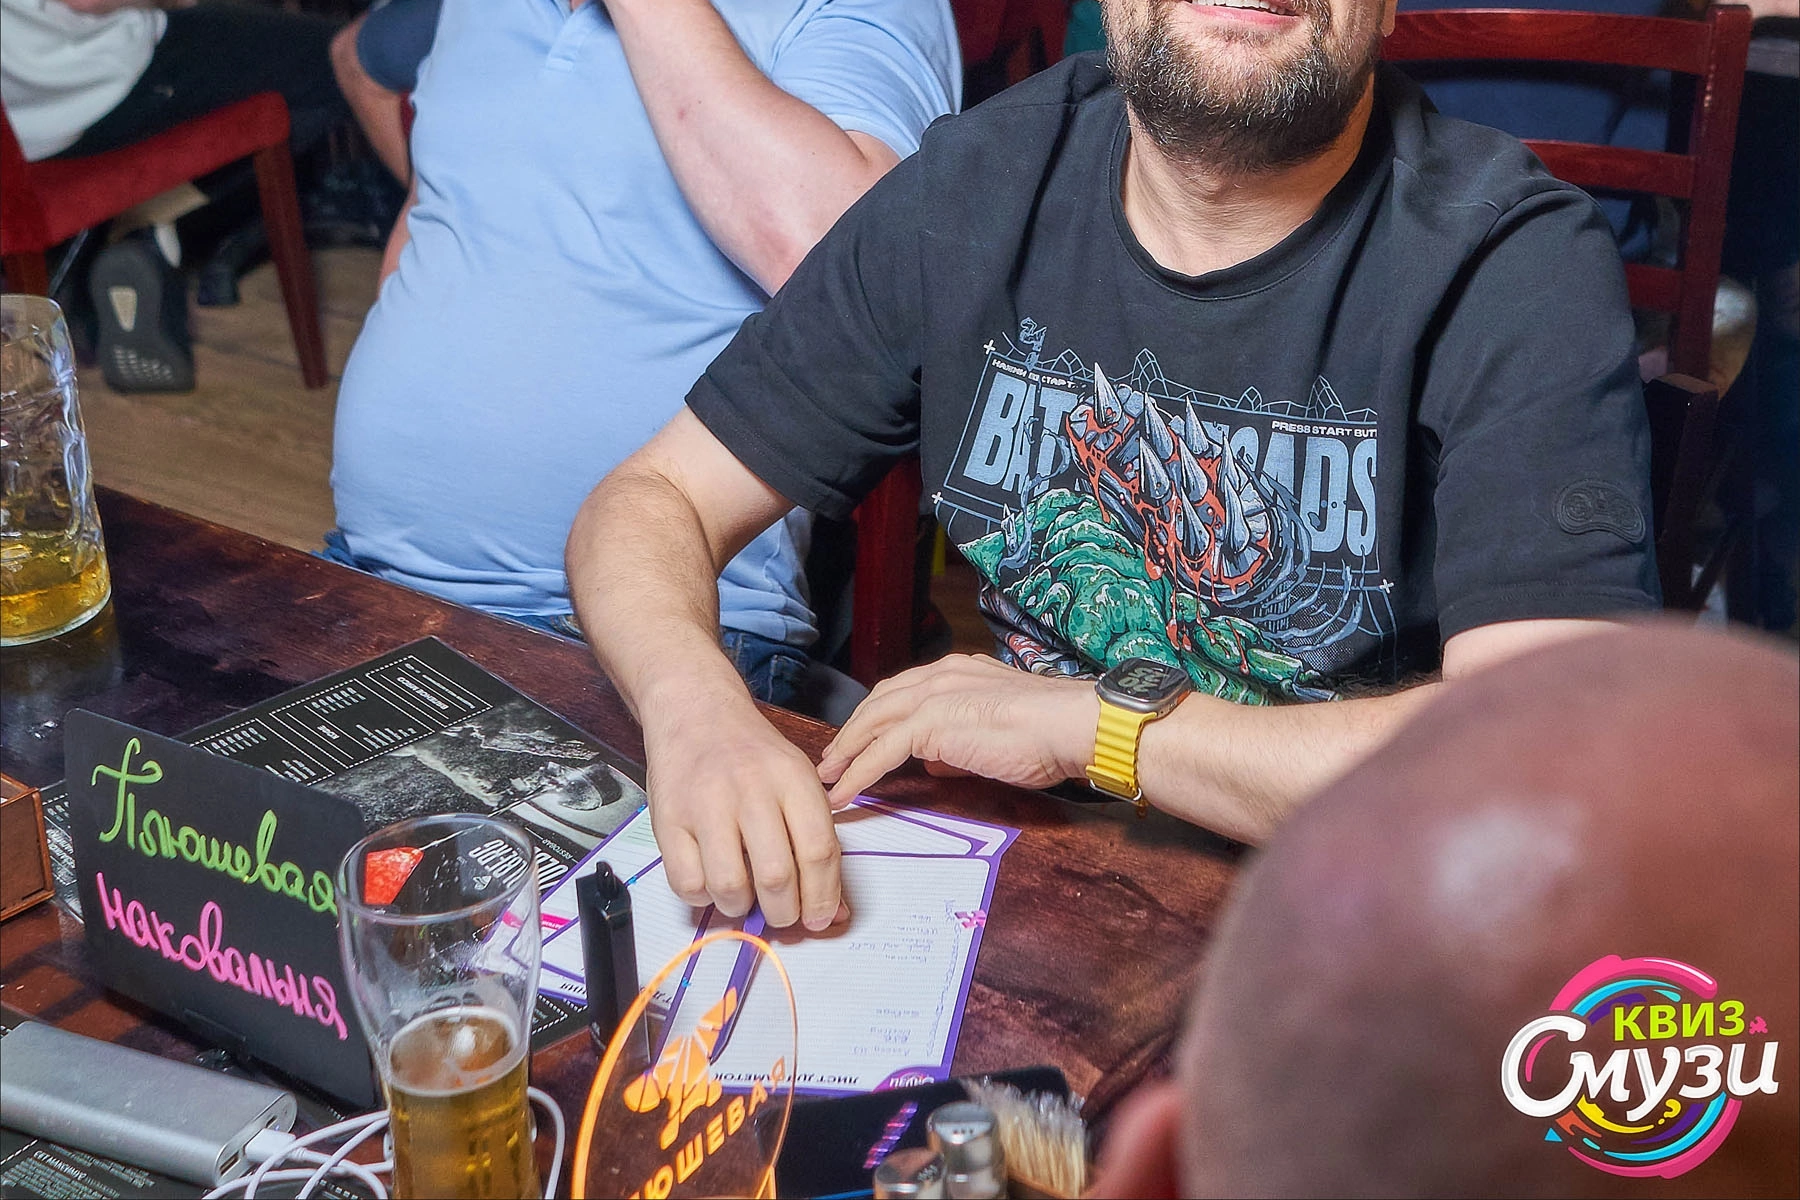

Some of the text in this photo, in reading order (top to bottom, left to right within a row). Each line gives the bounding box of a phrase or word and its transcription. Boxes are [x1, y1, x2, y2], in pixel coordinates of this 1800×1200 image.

[1271, 420, 1311, 434] PRESS
[1311, 425, 1352, 437] START
[541, 838, 573, 860] RESTOBAR
[818, 1073, 859, 1085] ЛИСТ
[628, 1056, 785, 1199] ЮШЕВАЯ
